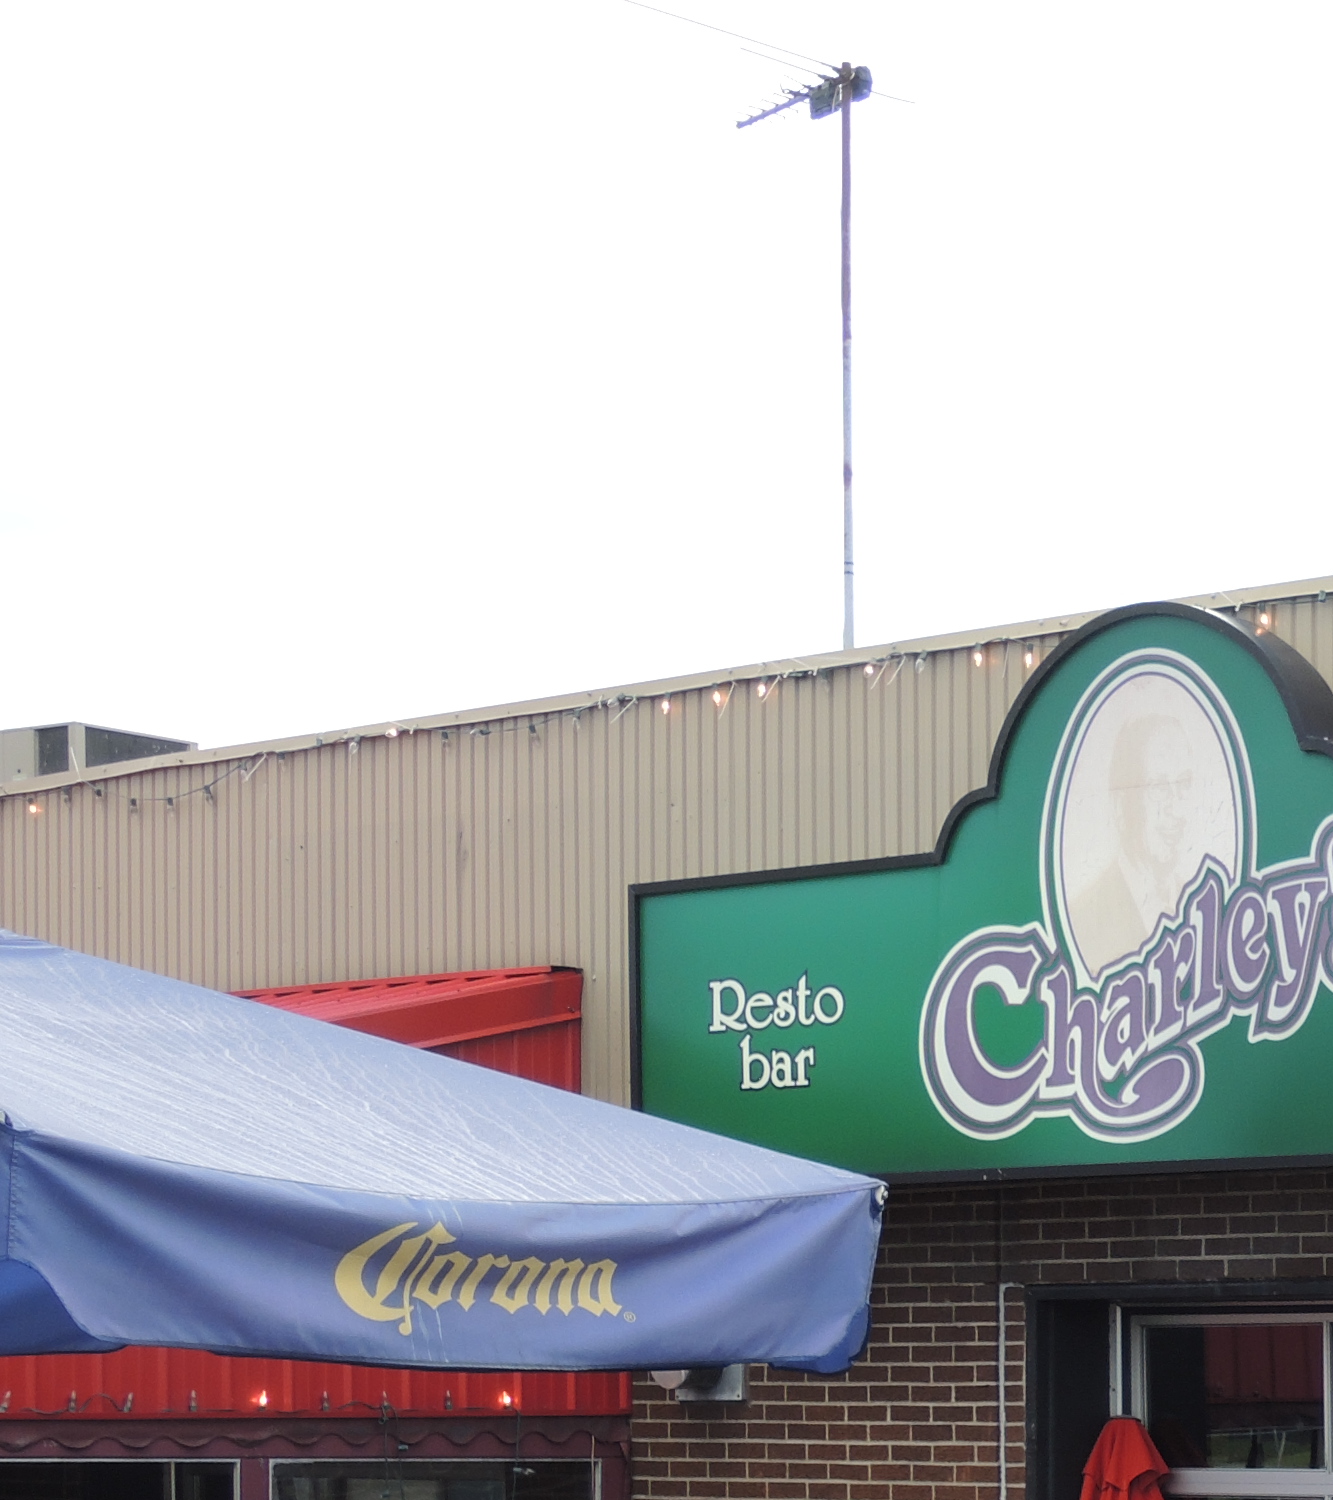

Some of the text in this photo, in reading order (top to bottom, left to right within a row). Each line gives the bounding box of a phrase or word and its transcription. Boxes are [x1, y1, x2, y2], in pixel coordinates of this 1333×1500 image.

[708, 970, 845, 1033] Resto
[739, 1034, 816, 1091] bar
[335, 1221, 623, 1336] Corona
